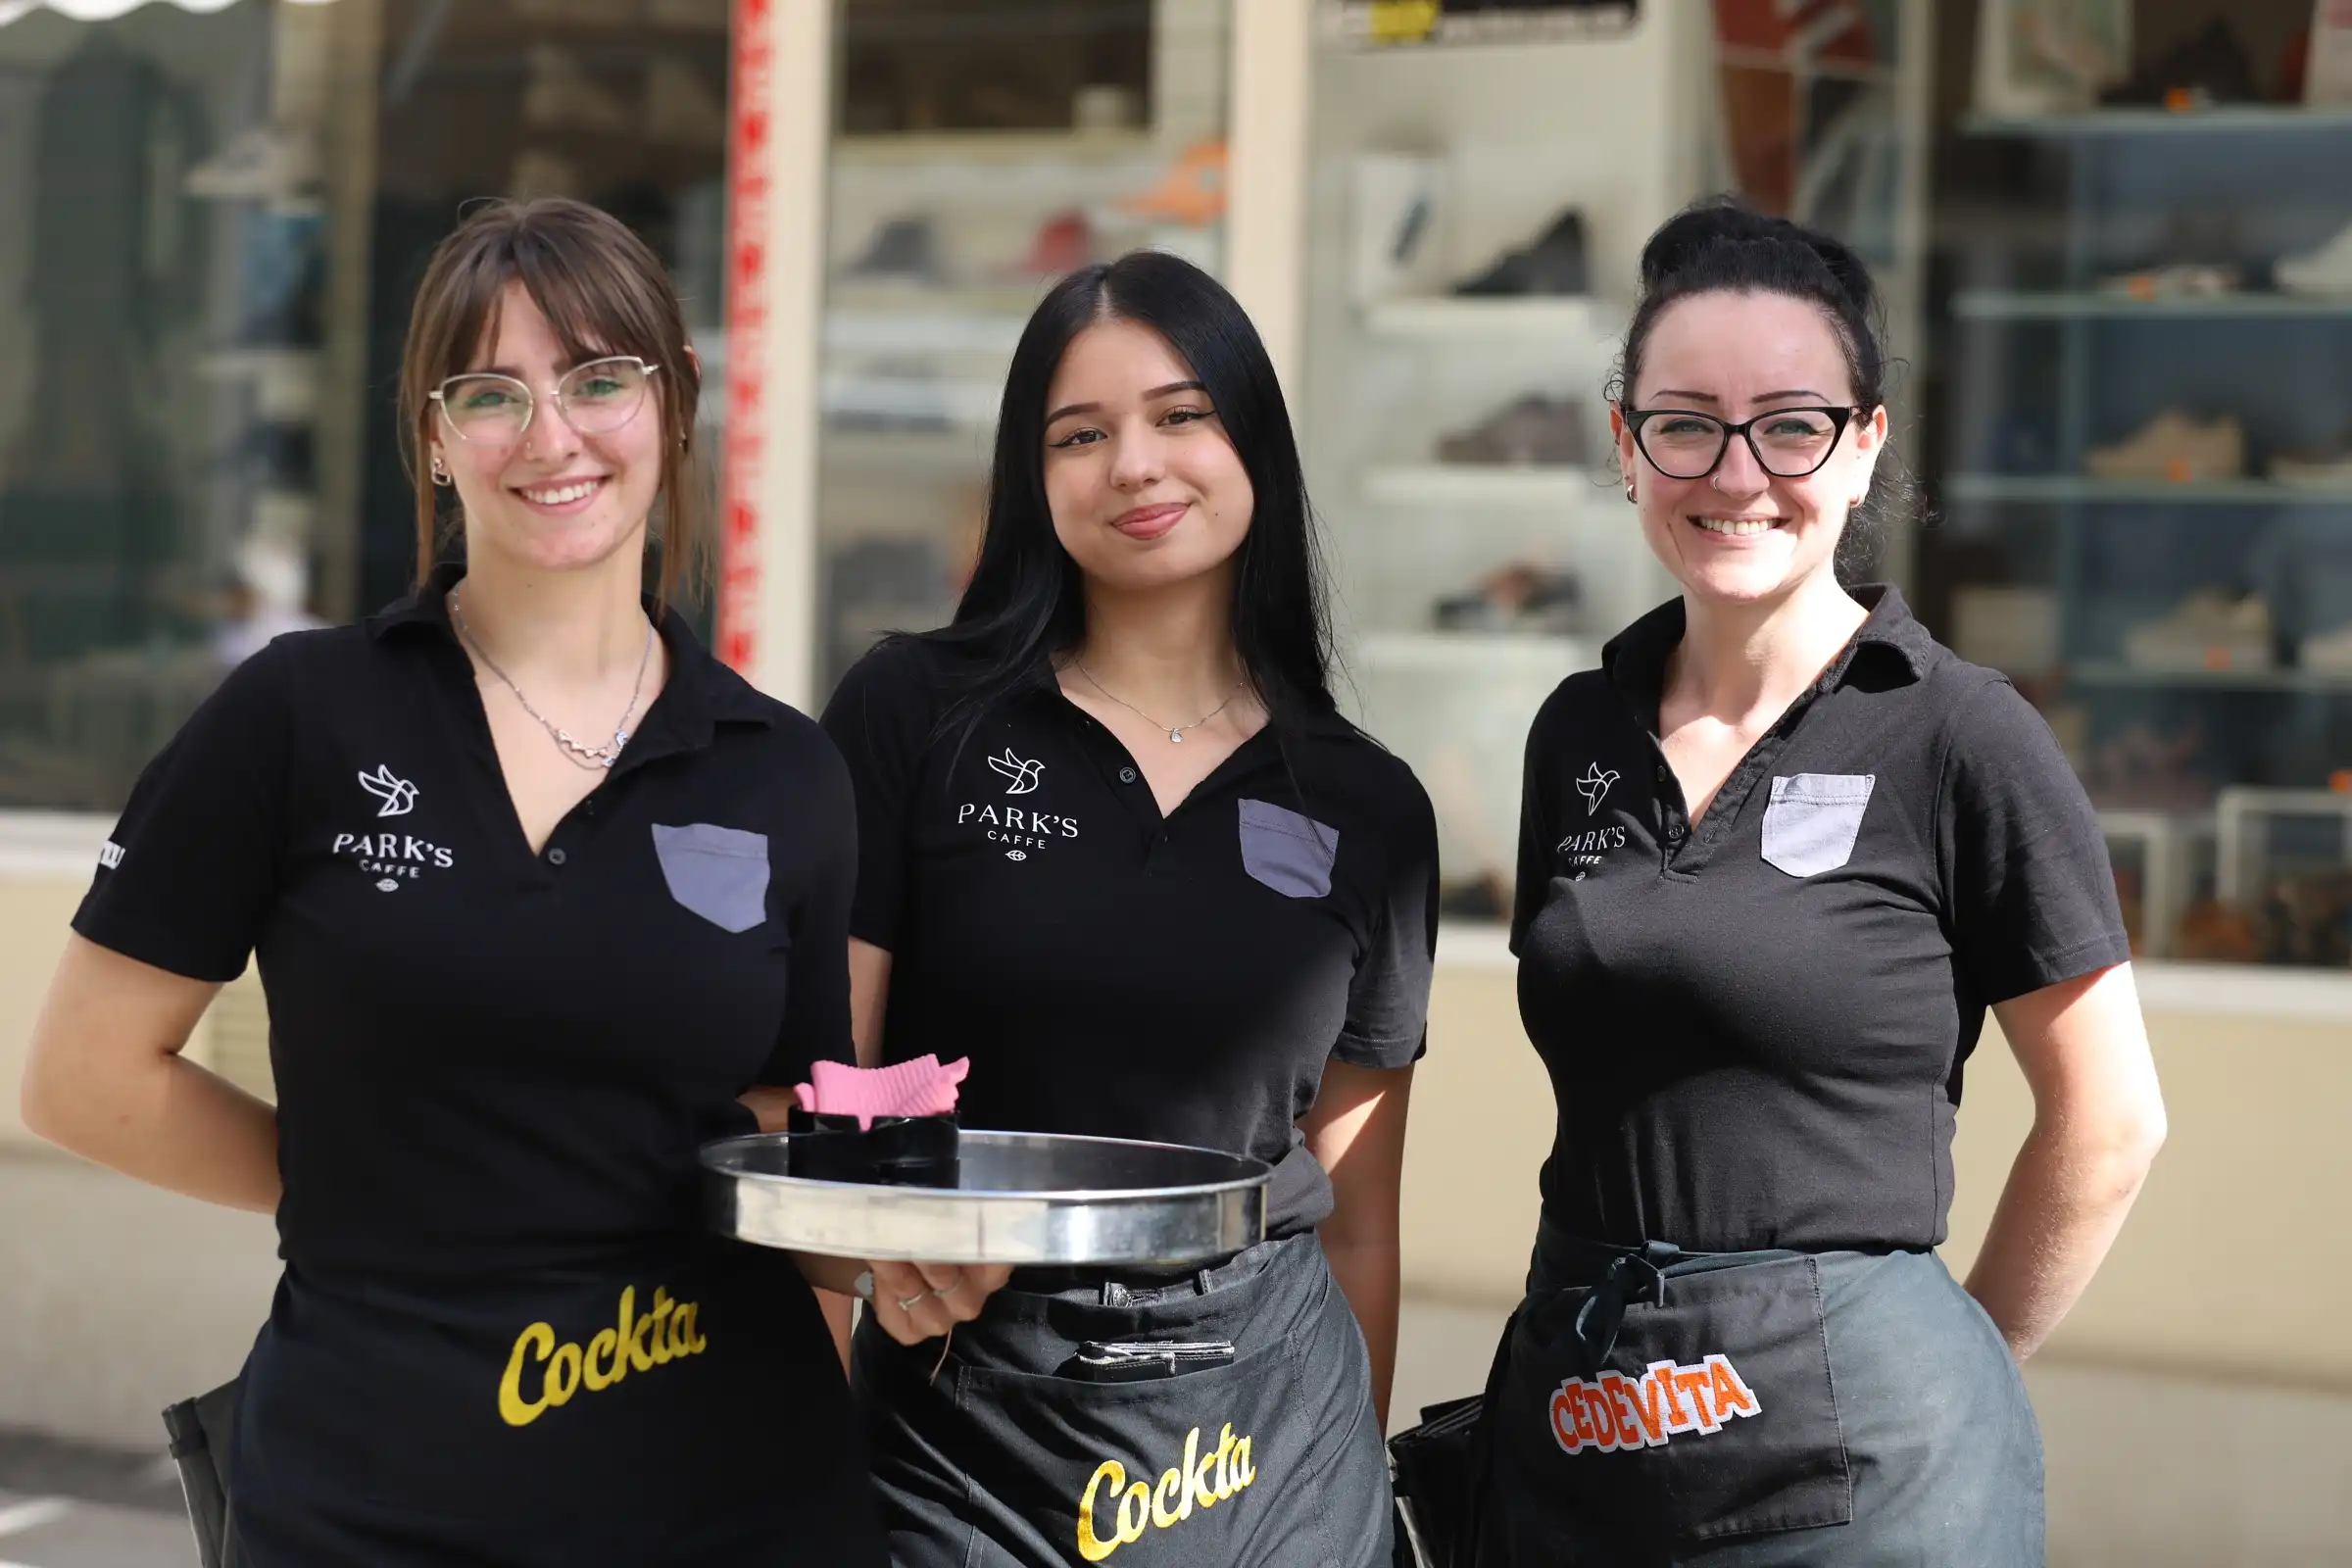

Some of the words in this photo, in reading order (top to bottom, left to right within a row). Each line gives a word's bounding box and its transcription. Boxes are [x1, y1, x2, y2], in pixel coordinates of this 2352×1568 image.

[957, 803, 1079, 838] PARK'S
[332, 833, 453, 868] PARK'S
[987, 830, 1046, 850] CAFFE
[1556, 825, 1626, 854] PARK'S
[359, 858, 420, 878] CAFFE
[498, 1284, 707, 1427] Cockta
[1552, 1360, 1752, 1449] CEDEVITA
[1077, 1422, 1256, 1561] Cockta
